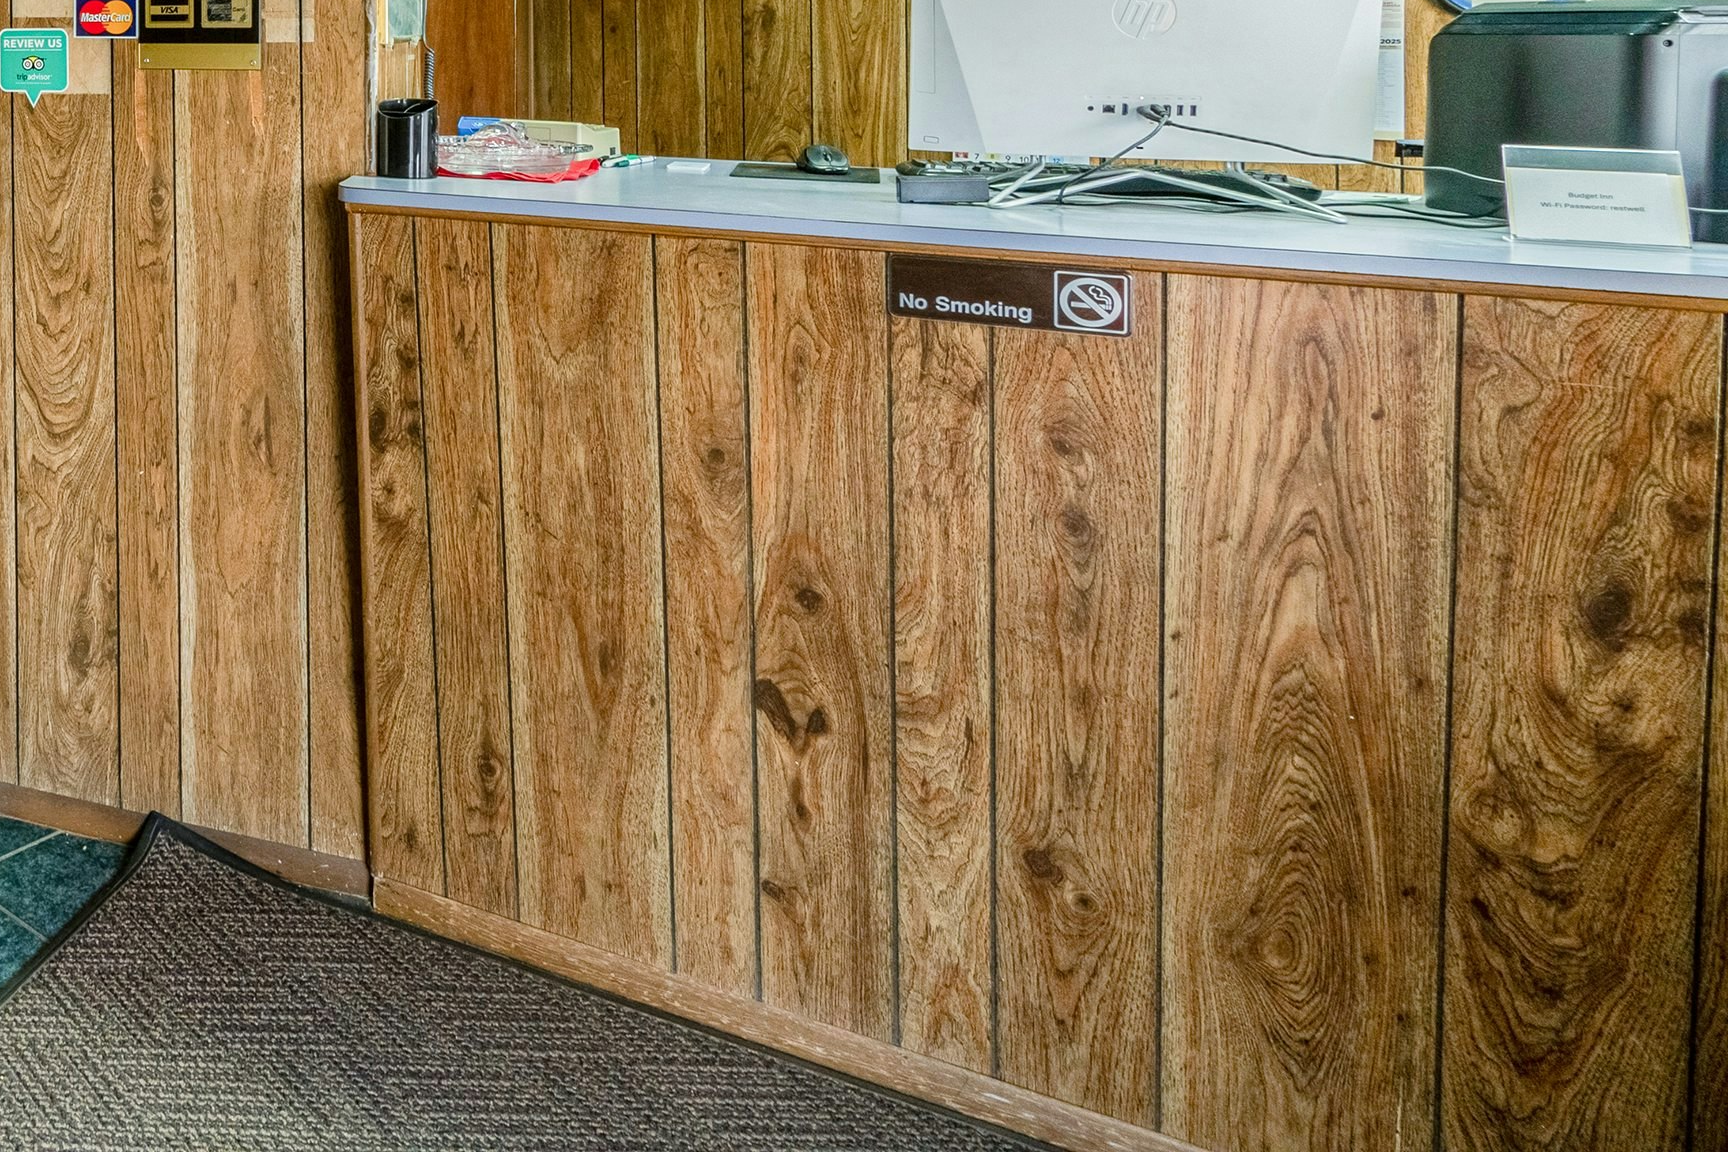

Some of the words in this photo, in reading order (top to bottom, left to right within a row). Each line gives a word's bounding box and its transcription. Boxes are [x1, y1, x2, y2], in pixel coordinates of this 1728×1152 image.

[80, 12, 132, 24] MasterCard
[4, 39, 44, 48] REVIEW
[48, 39, 62, 48] US
[17, 73, 50, 81] tripadvisor
[899, 293, 928, 310] No
[936, 296, 1032, 323] Smoking
